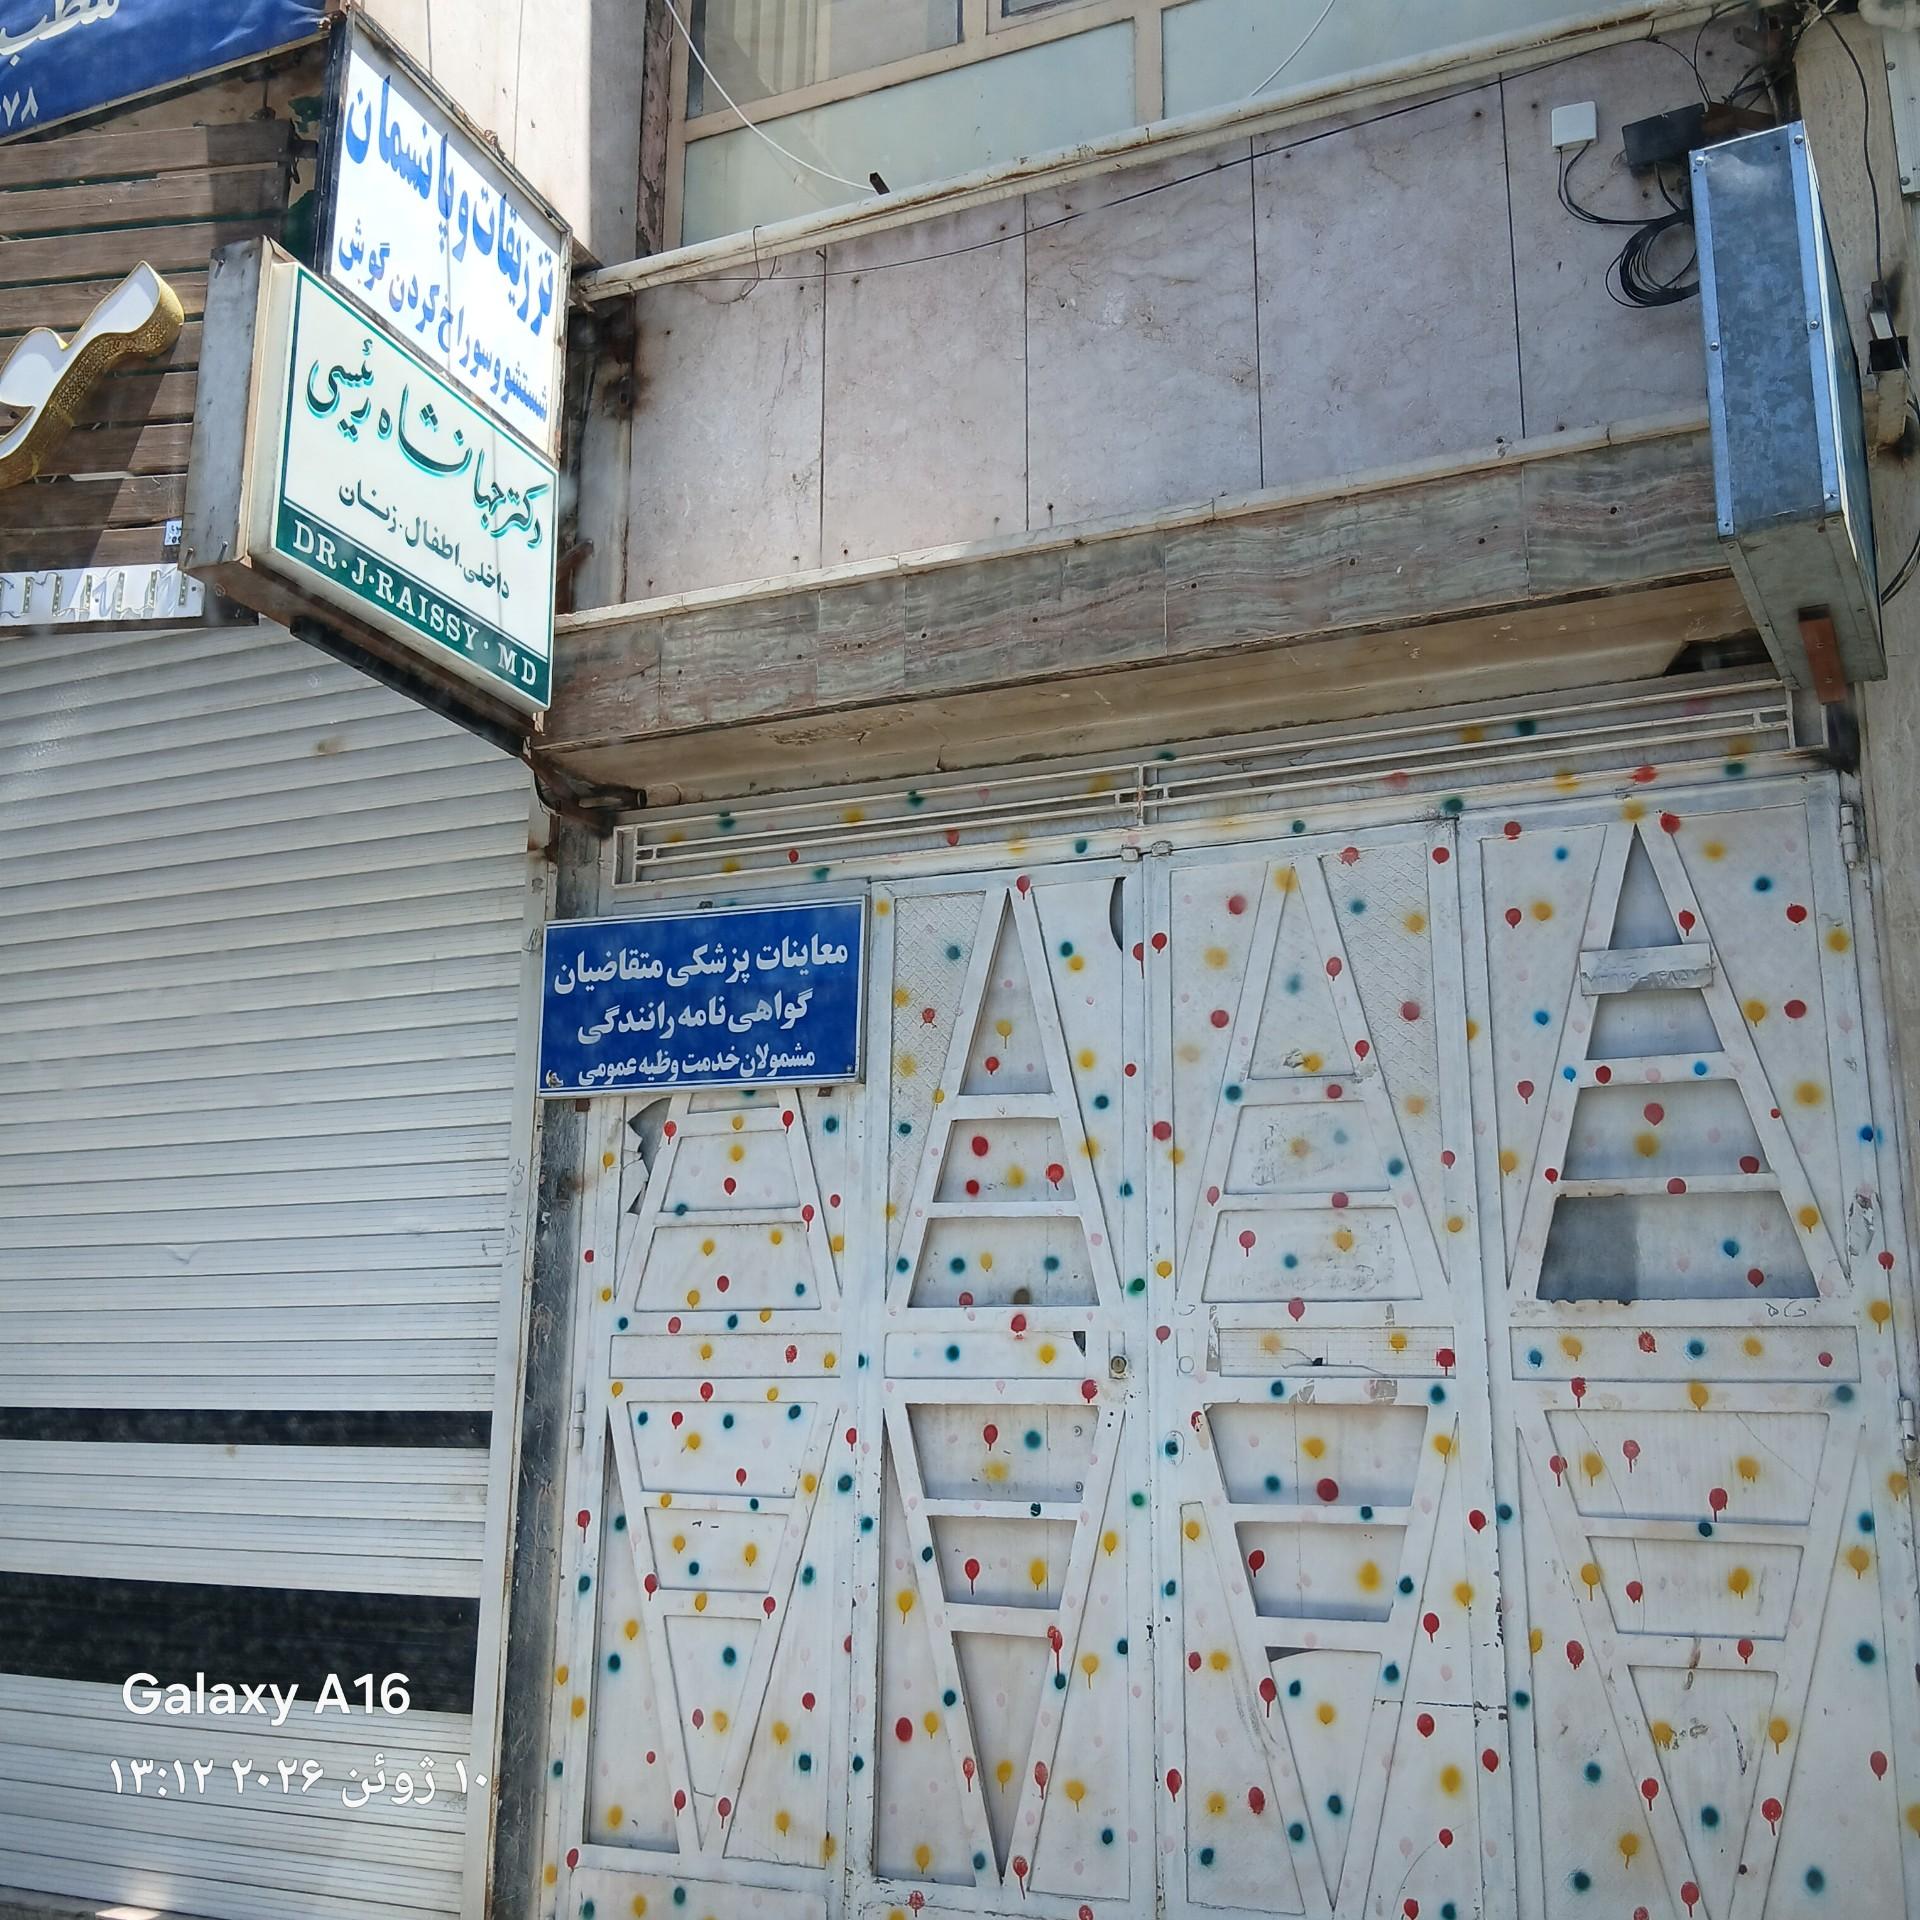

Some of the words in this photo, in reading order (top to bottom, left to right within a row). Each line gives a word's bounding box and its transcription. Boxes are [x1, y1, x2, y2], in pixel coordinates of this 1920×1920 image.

[346, 75, 454, 253] پانسمان
[452, 190, 468, 262] و
[339, 217, 390, 291] گوش
[389, 274, 440, 333] کردن
[438, 293, 493, 378] سوراخ
[501, 361, 547, 422] شستشو
[490, 483, 550, 549] دکتر
[554, 948, 663, 994] متقاضیان
[666, 942, 750, 987] پزشکی
[755, 932, 848, 975] معاینات
[577, 1001, 675, 1045] رانندگی
[578, 1057, 637, 1086] عمومی
[681, 1045, 740, 1074] خدمت
[739, 1042, 815, 1078] مشمولان
